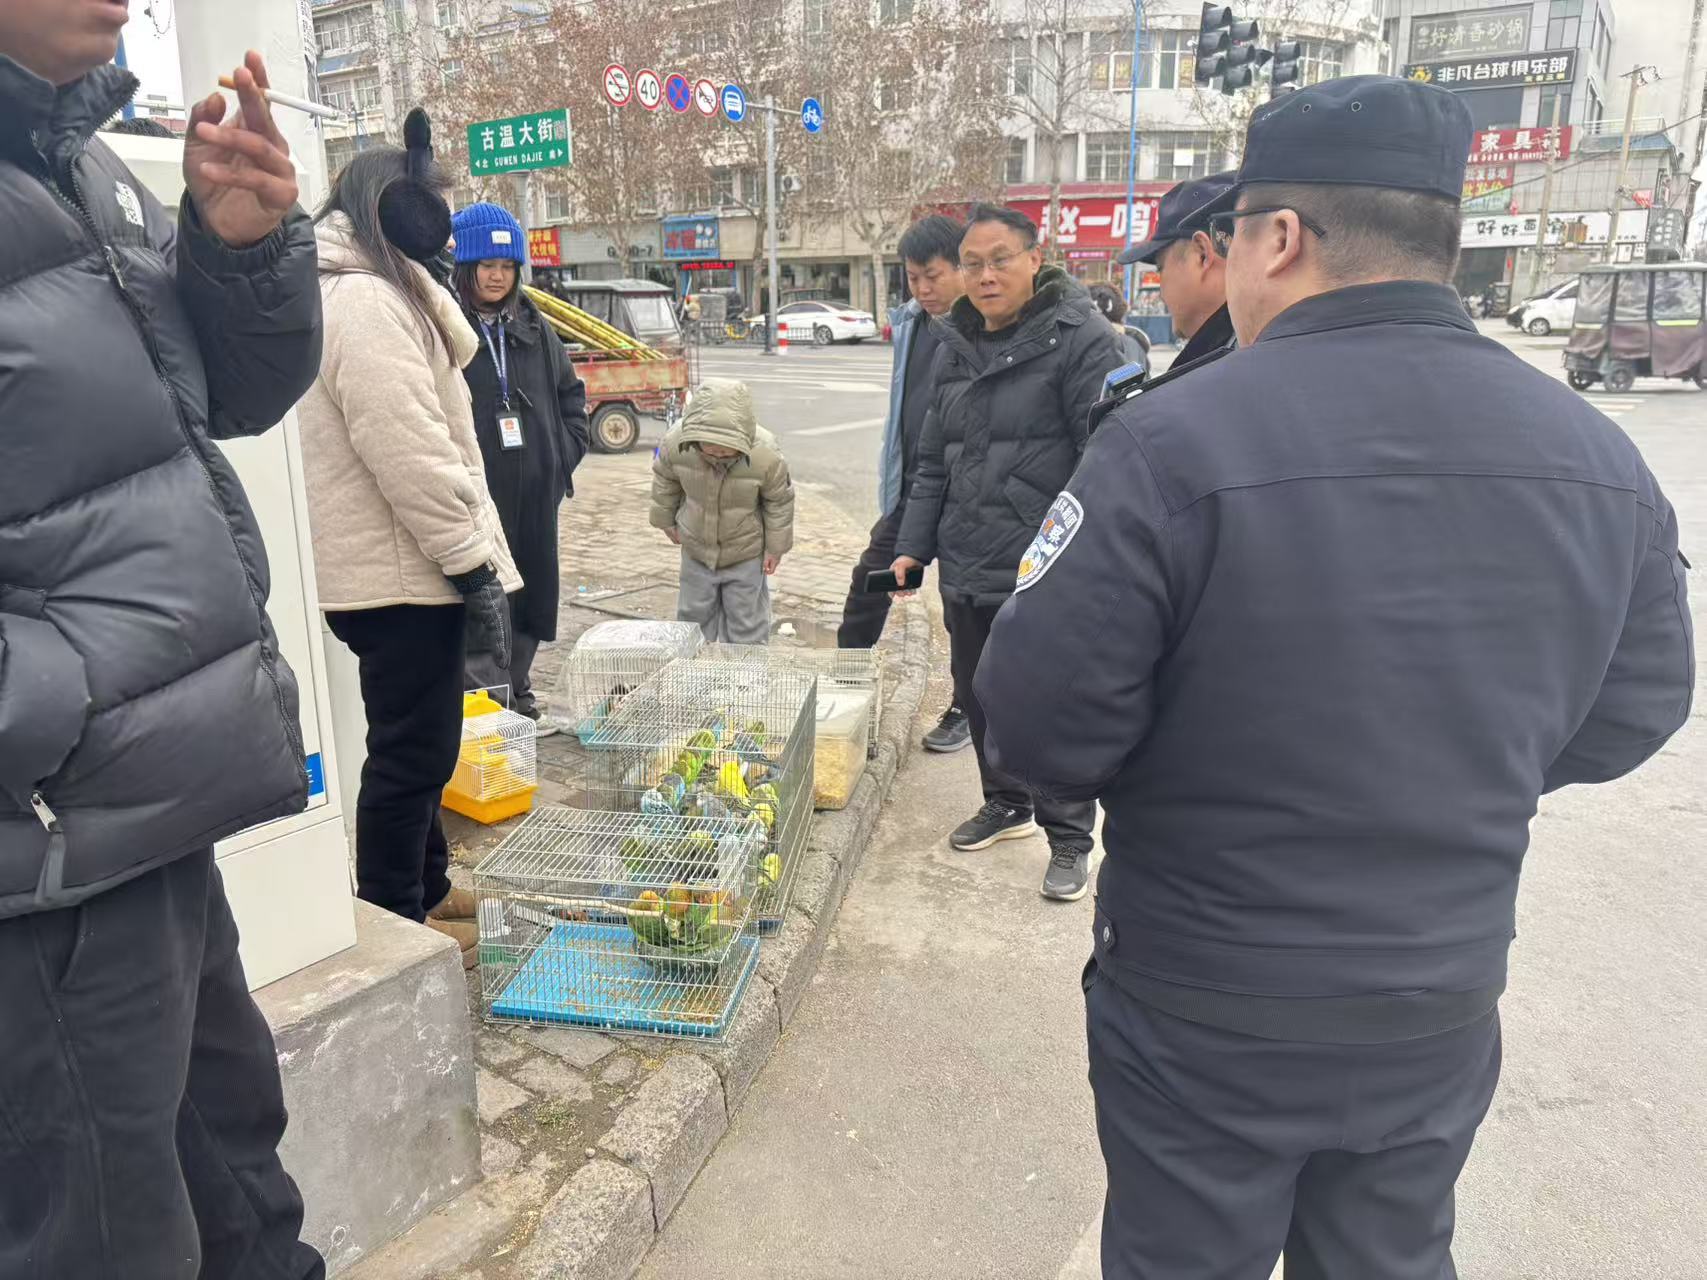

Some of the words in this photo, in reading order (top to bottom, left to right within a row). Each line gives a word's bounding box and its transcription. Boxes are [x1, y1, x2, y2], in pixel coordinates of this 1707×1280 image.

[1437, 56, 1569, 83] 非凡台球俱乐部
[640, 79, 658, 100] 40
[480, 118, 553, 152] 古温大街
[494, 154, 518, 167] GUWEN
[521, 151, 543, 163] DAJIE
